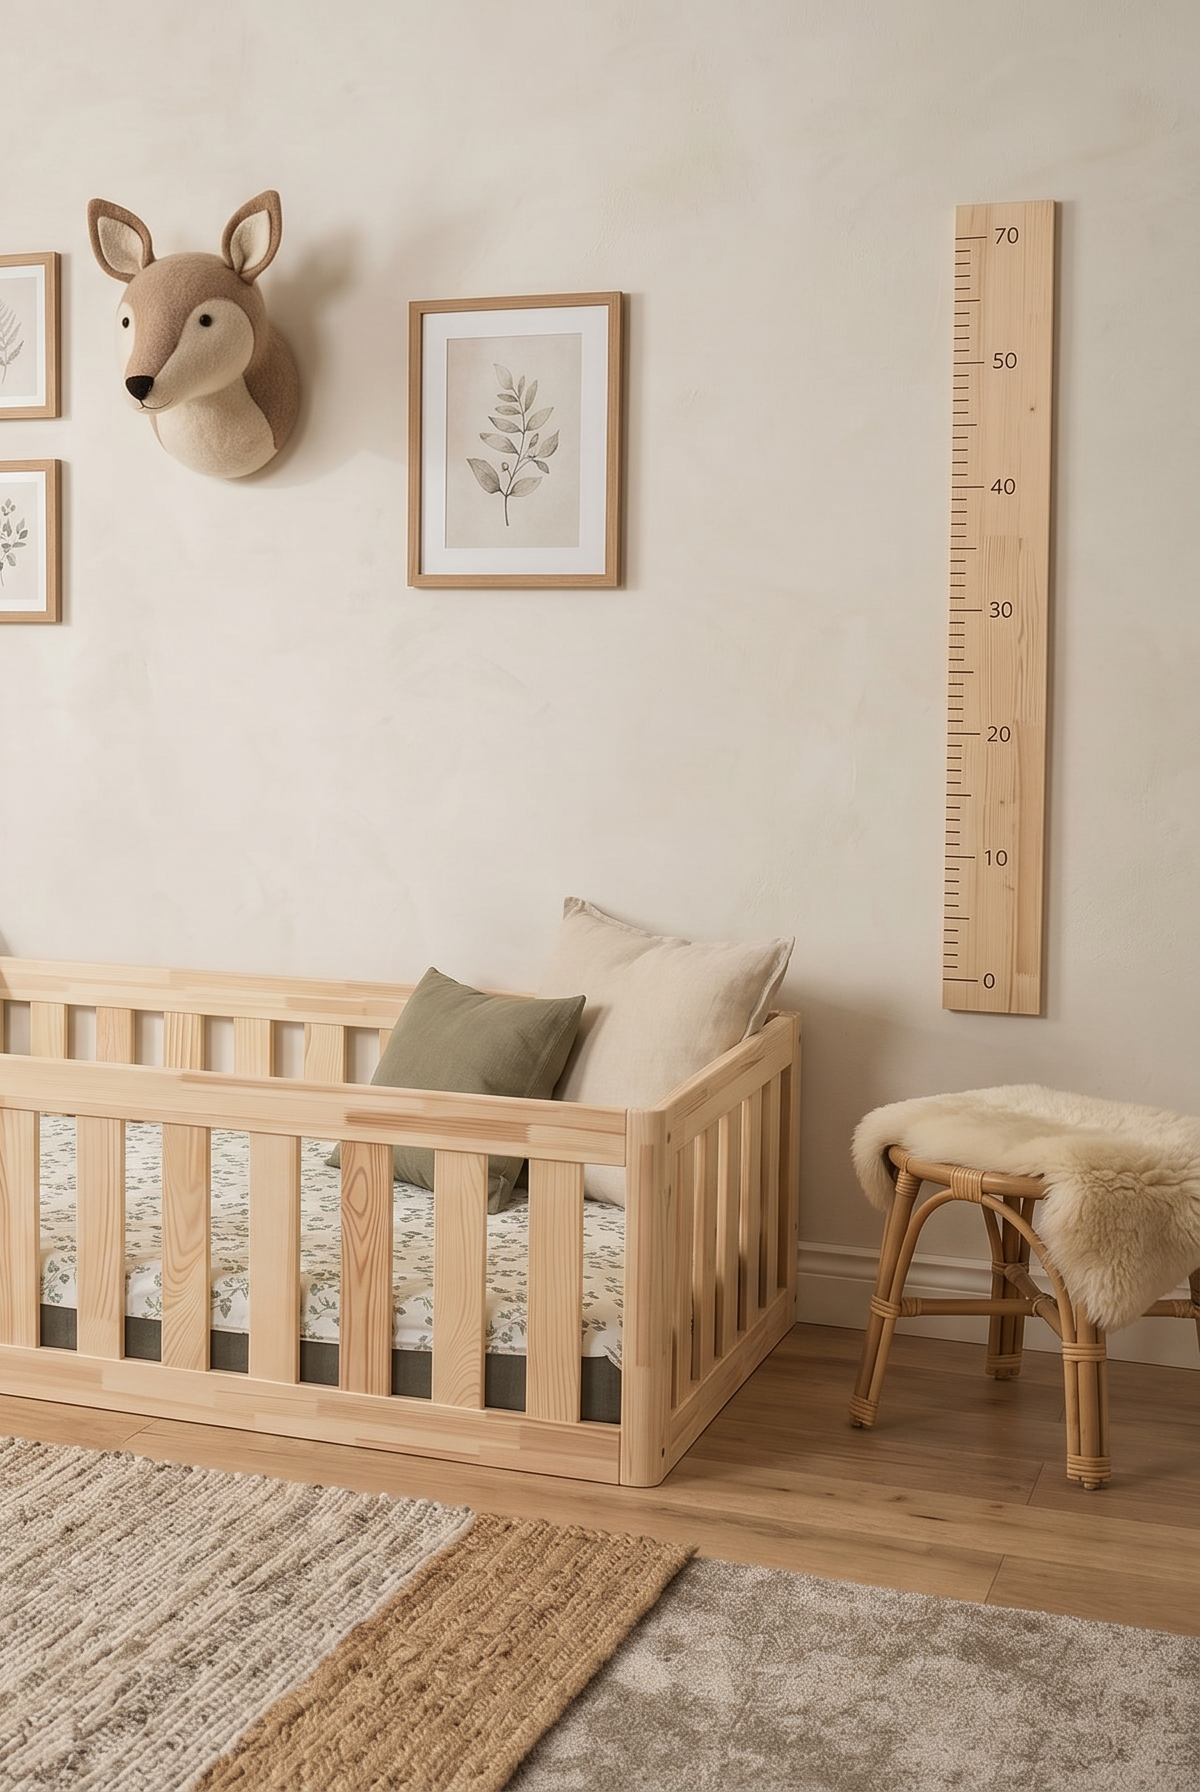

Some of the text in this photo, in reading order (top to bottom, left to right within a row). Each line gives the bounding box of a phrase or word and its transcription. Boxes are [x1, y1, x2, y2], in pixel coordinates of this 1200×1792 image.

[994, 226, 1019, 245] 70
[992, 352, 1018, 370] 50
[990, 478, 1016, 495] 40
[989, 601, 1013, 619] 30
[987, 725, 1011, 743] 20
[984, 849, 1008, 867] 10
[983, 972, 996, 990] 0
